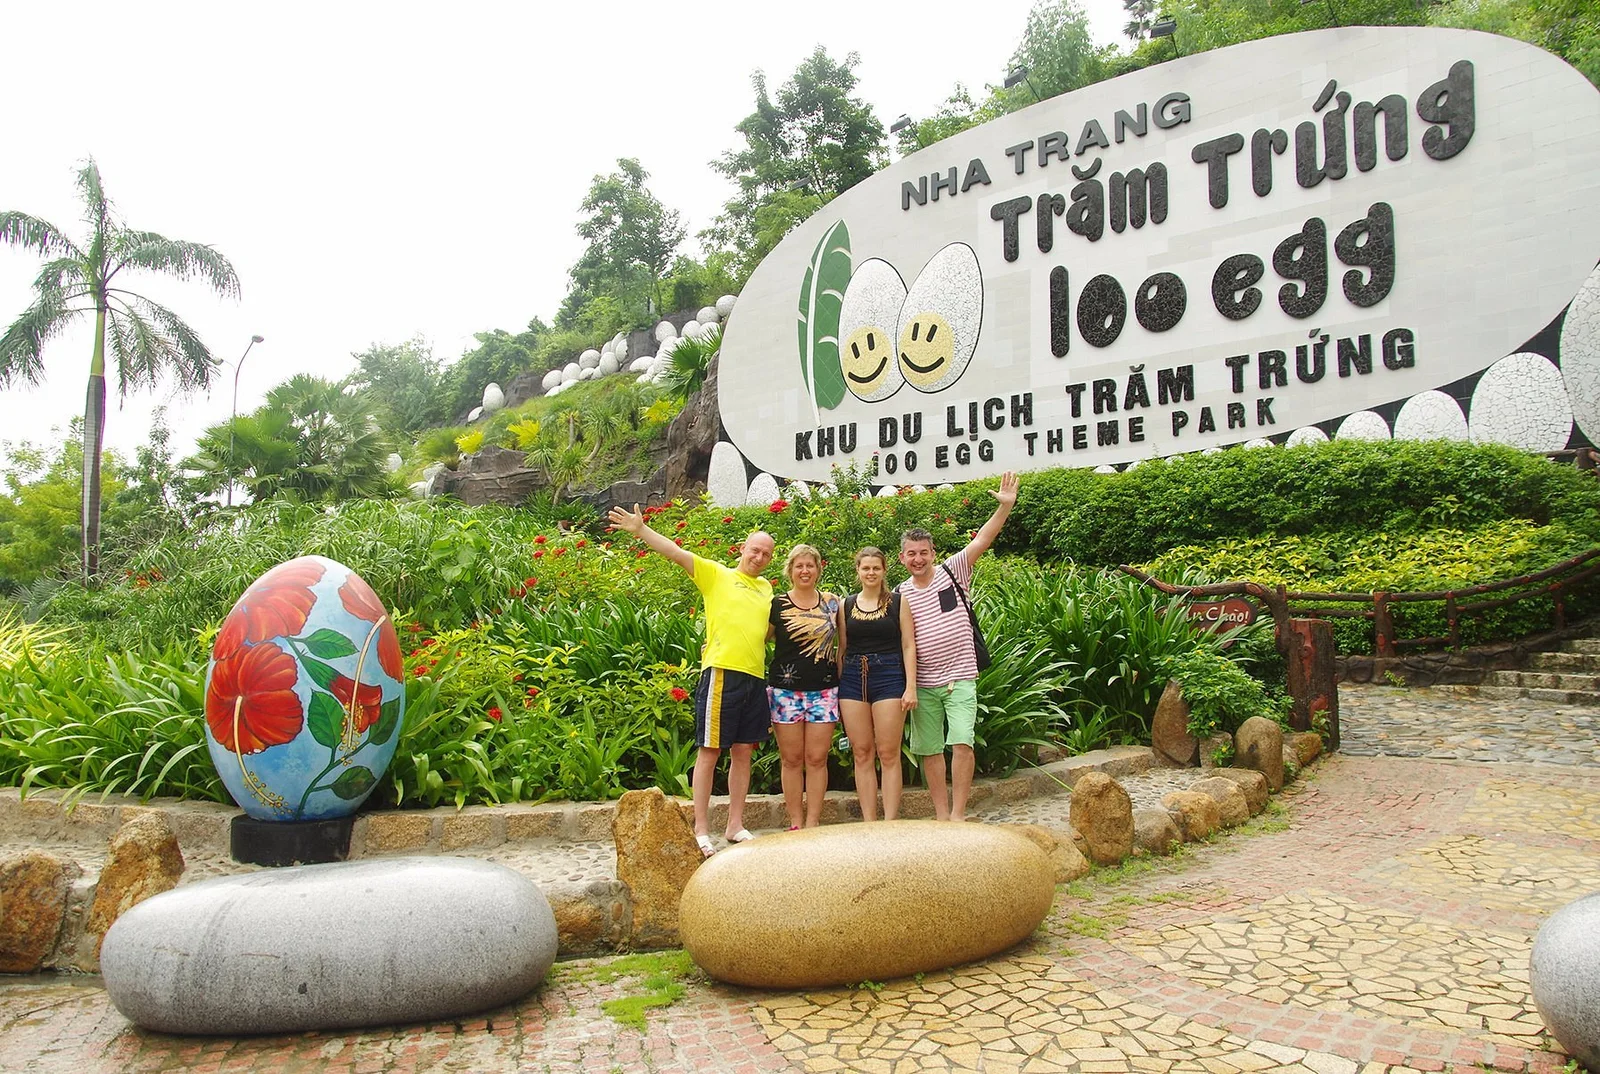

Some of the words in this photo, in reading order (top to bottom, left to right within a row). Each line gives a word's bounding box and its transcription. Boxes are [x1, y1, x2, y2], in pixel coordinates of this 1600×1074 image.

[901, 158, 992, 210] NHA
[1005, 91, 1191, 174] TRANG
[990, 157, 1169, 263] Trăm
[1191, 59, 1476, 209] Trứng
[1212, 201, 1396, 321] egg
[795, 422, 857, 462] KHU
[879, 412, 922, 448] DU
[947, 392, 1033, 441] LỊCH
[1065, 363, 1194, 418] TRĂM
[1225, 327, 1415, 394] TRỨNG
[872, 450, 917, 477] 100
[935, 439, 993, 469] EGG
[1024, 416, 1146, 457] THEME
[1171, 397, 1276, 437] PARK
